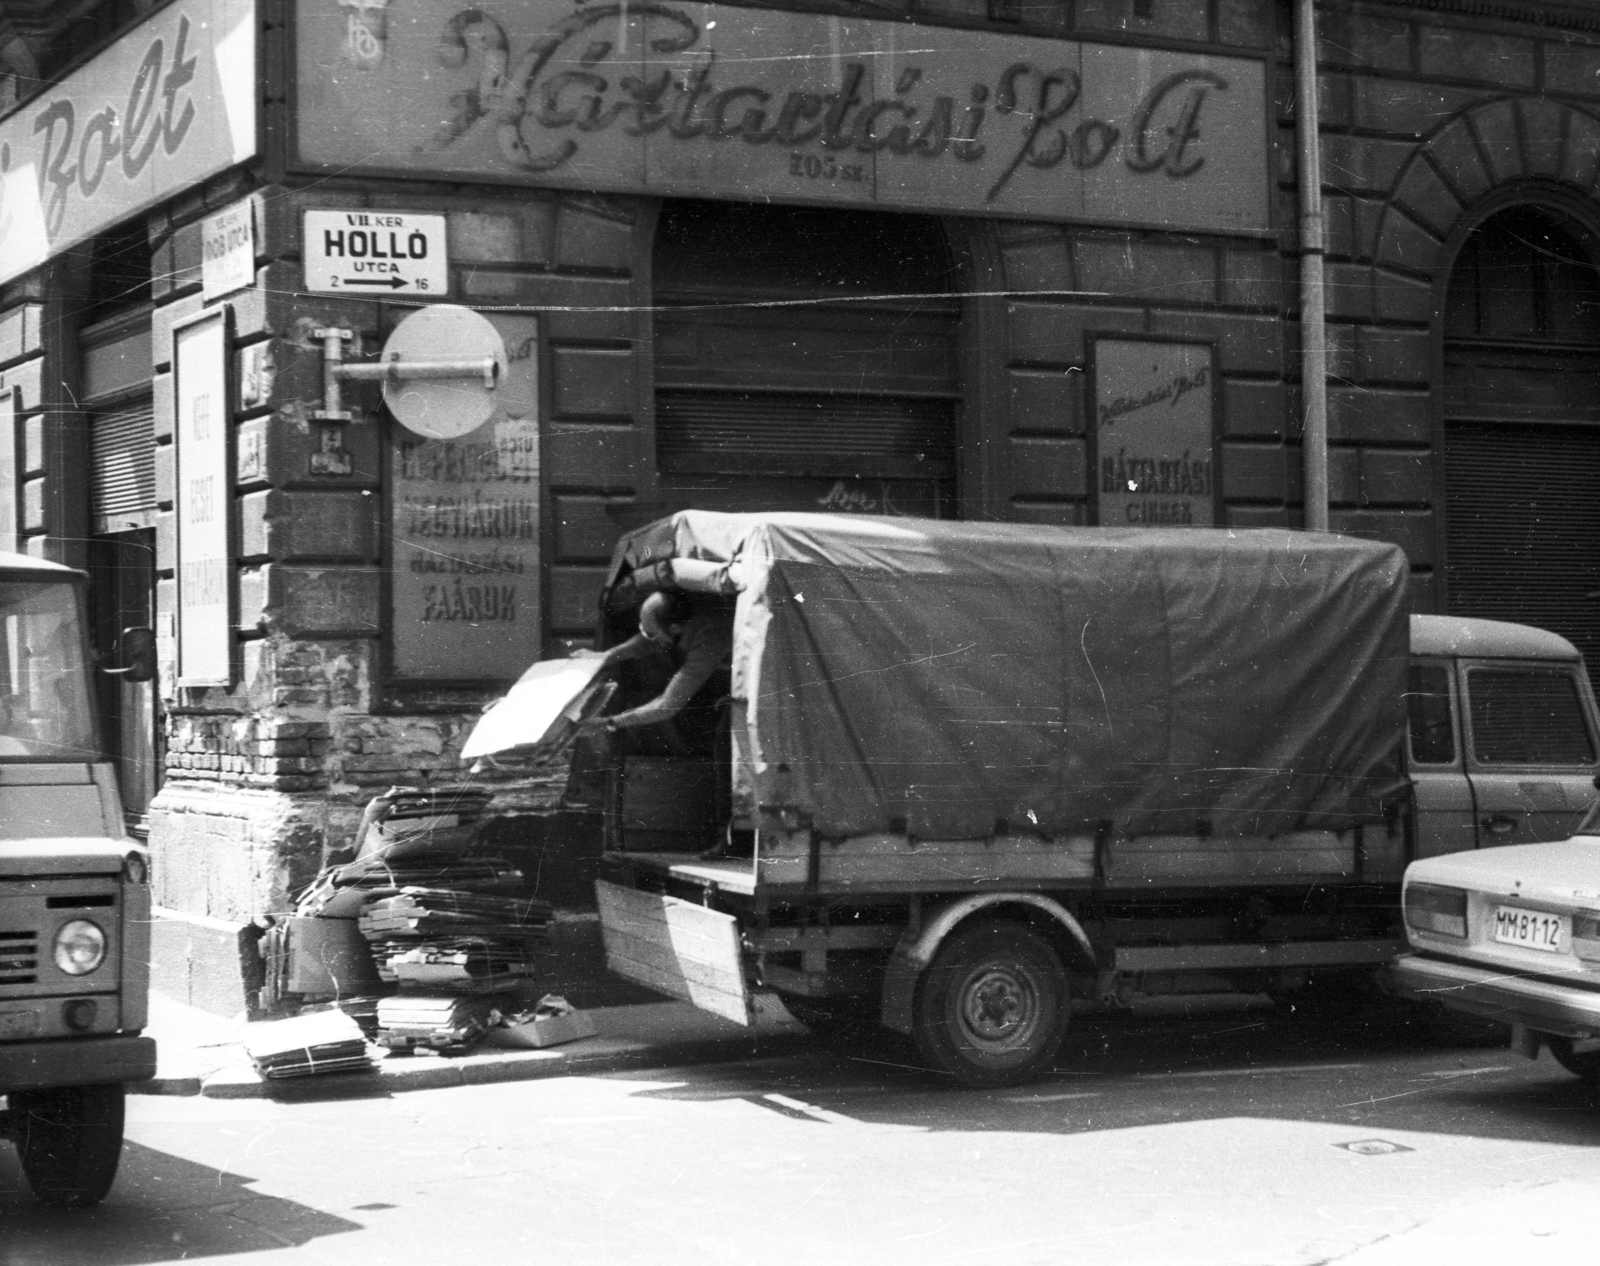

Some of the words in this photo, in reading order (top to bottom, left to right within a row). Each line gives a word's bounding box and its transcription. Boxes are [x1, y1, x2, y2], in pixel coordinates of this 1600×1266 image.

[33, 12, 199, 246] Bolt
[985, 61, 1229, 203] Bolt
[324, 228, 428, 260] HOLLÓ
[329, 275, 341, 288] 2
[414, 278, 430, 291] 16
[353, 261, 400, 274] UTCA
